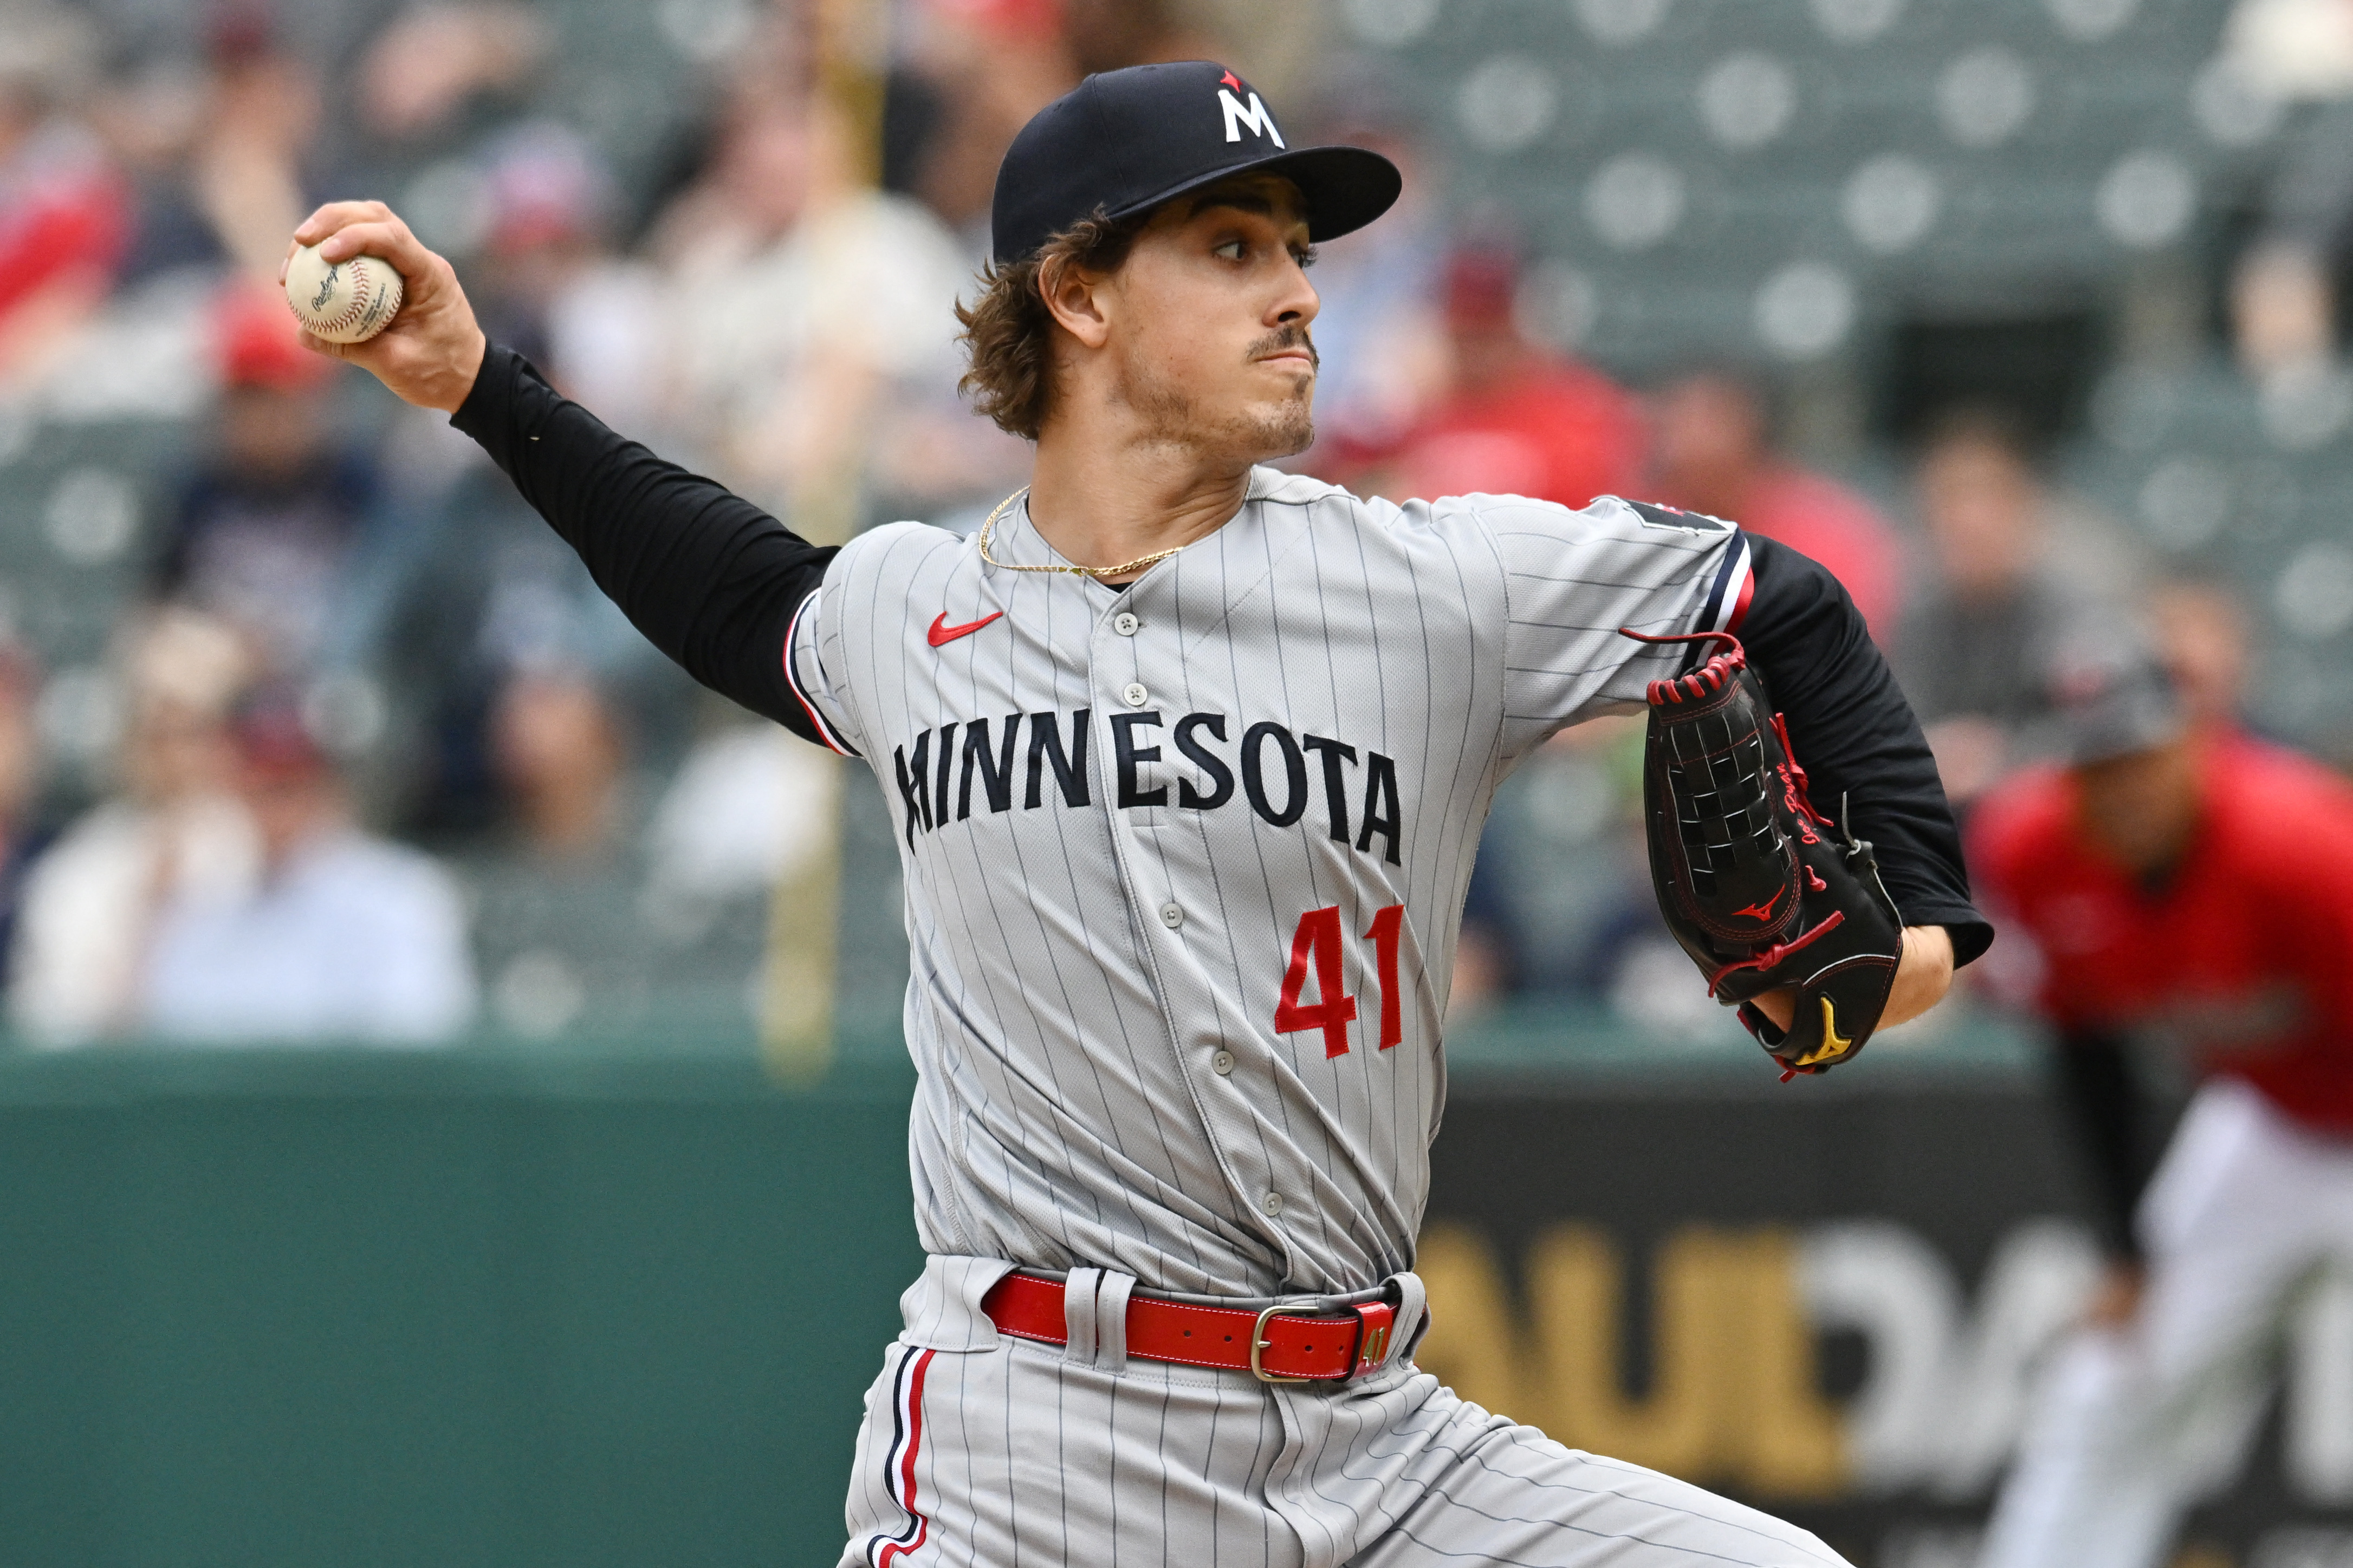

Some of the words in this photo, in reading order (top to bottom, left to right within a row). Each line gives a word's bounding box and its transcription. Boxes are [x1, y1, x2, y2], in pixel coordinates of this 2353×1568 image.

[1217, 89, 1285, 149] M
[894, 708, 1401, 867] MINNESOTA
[1274, 905, 1405, 1059] 41
[1363, 1327, 1385, 1367] 41
